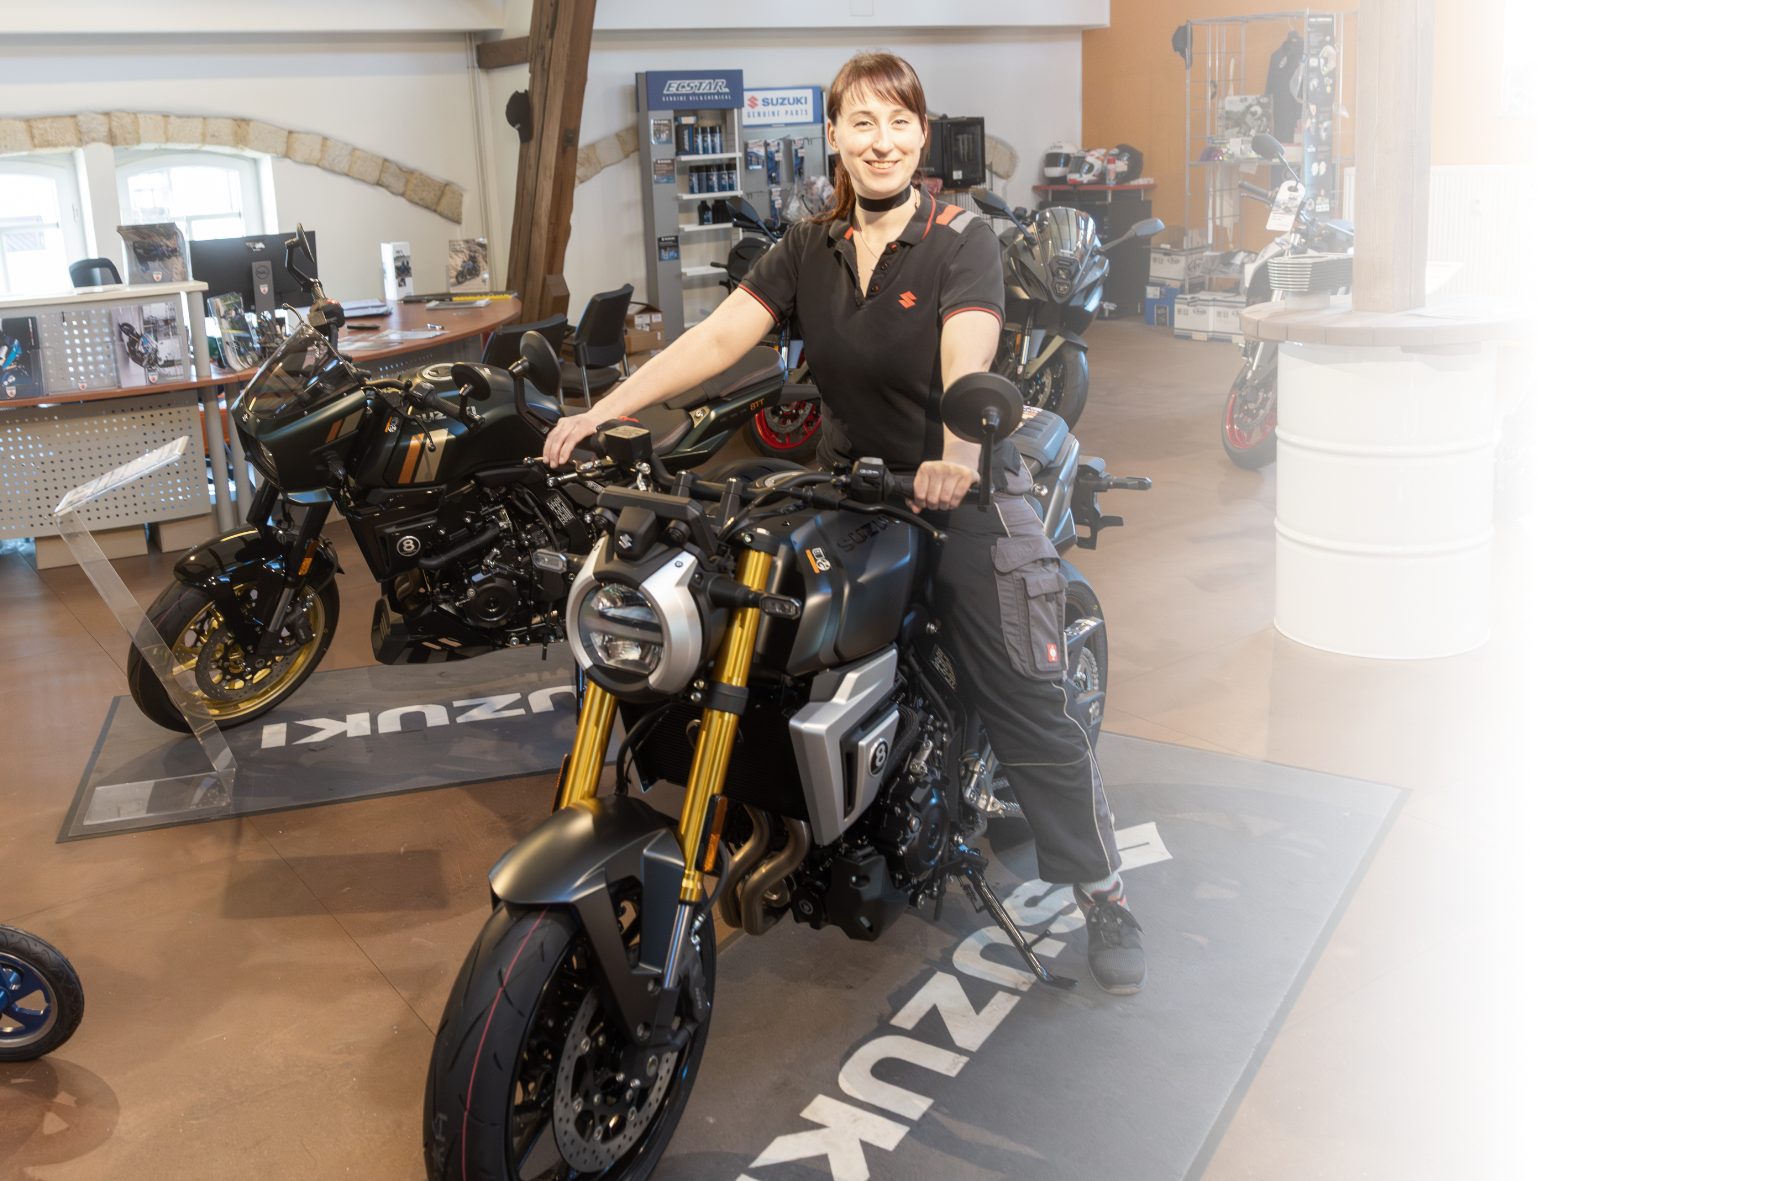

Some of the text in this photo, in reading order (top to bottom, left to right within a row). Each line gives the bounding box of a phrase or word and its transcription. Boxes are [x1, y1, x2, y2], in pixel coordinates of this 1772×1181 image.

[663, 79, 730, 94] ECSTAR
[761, 96, 808, 107] SUZUKI
[747, 108, 809, 119] GENUINE PARTS
[402, 539, 416, 552] 8
[260, 684, 587, 749] UZUKI
[875, 743, 886, 767] 8
[733, 878, 1087, 1181] SUZUK
